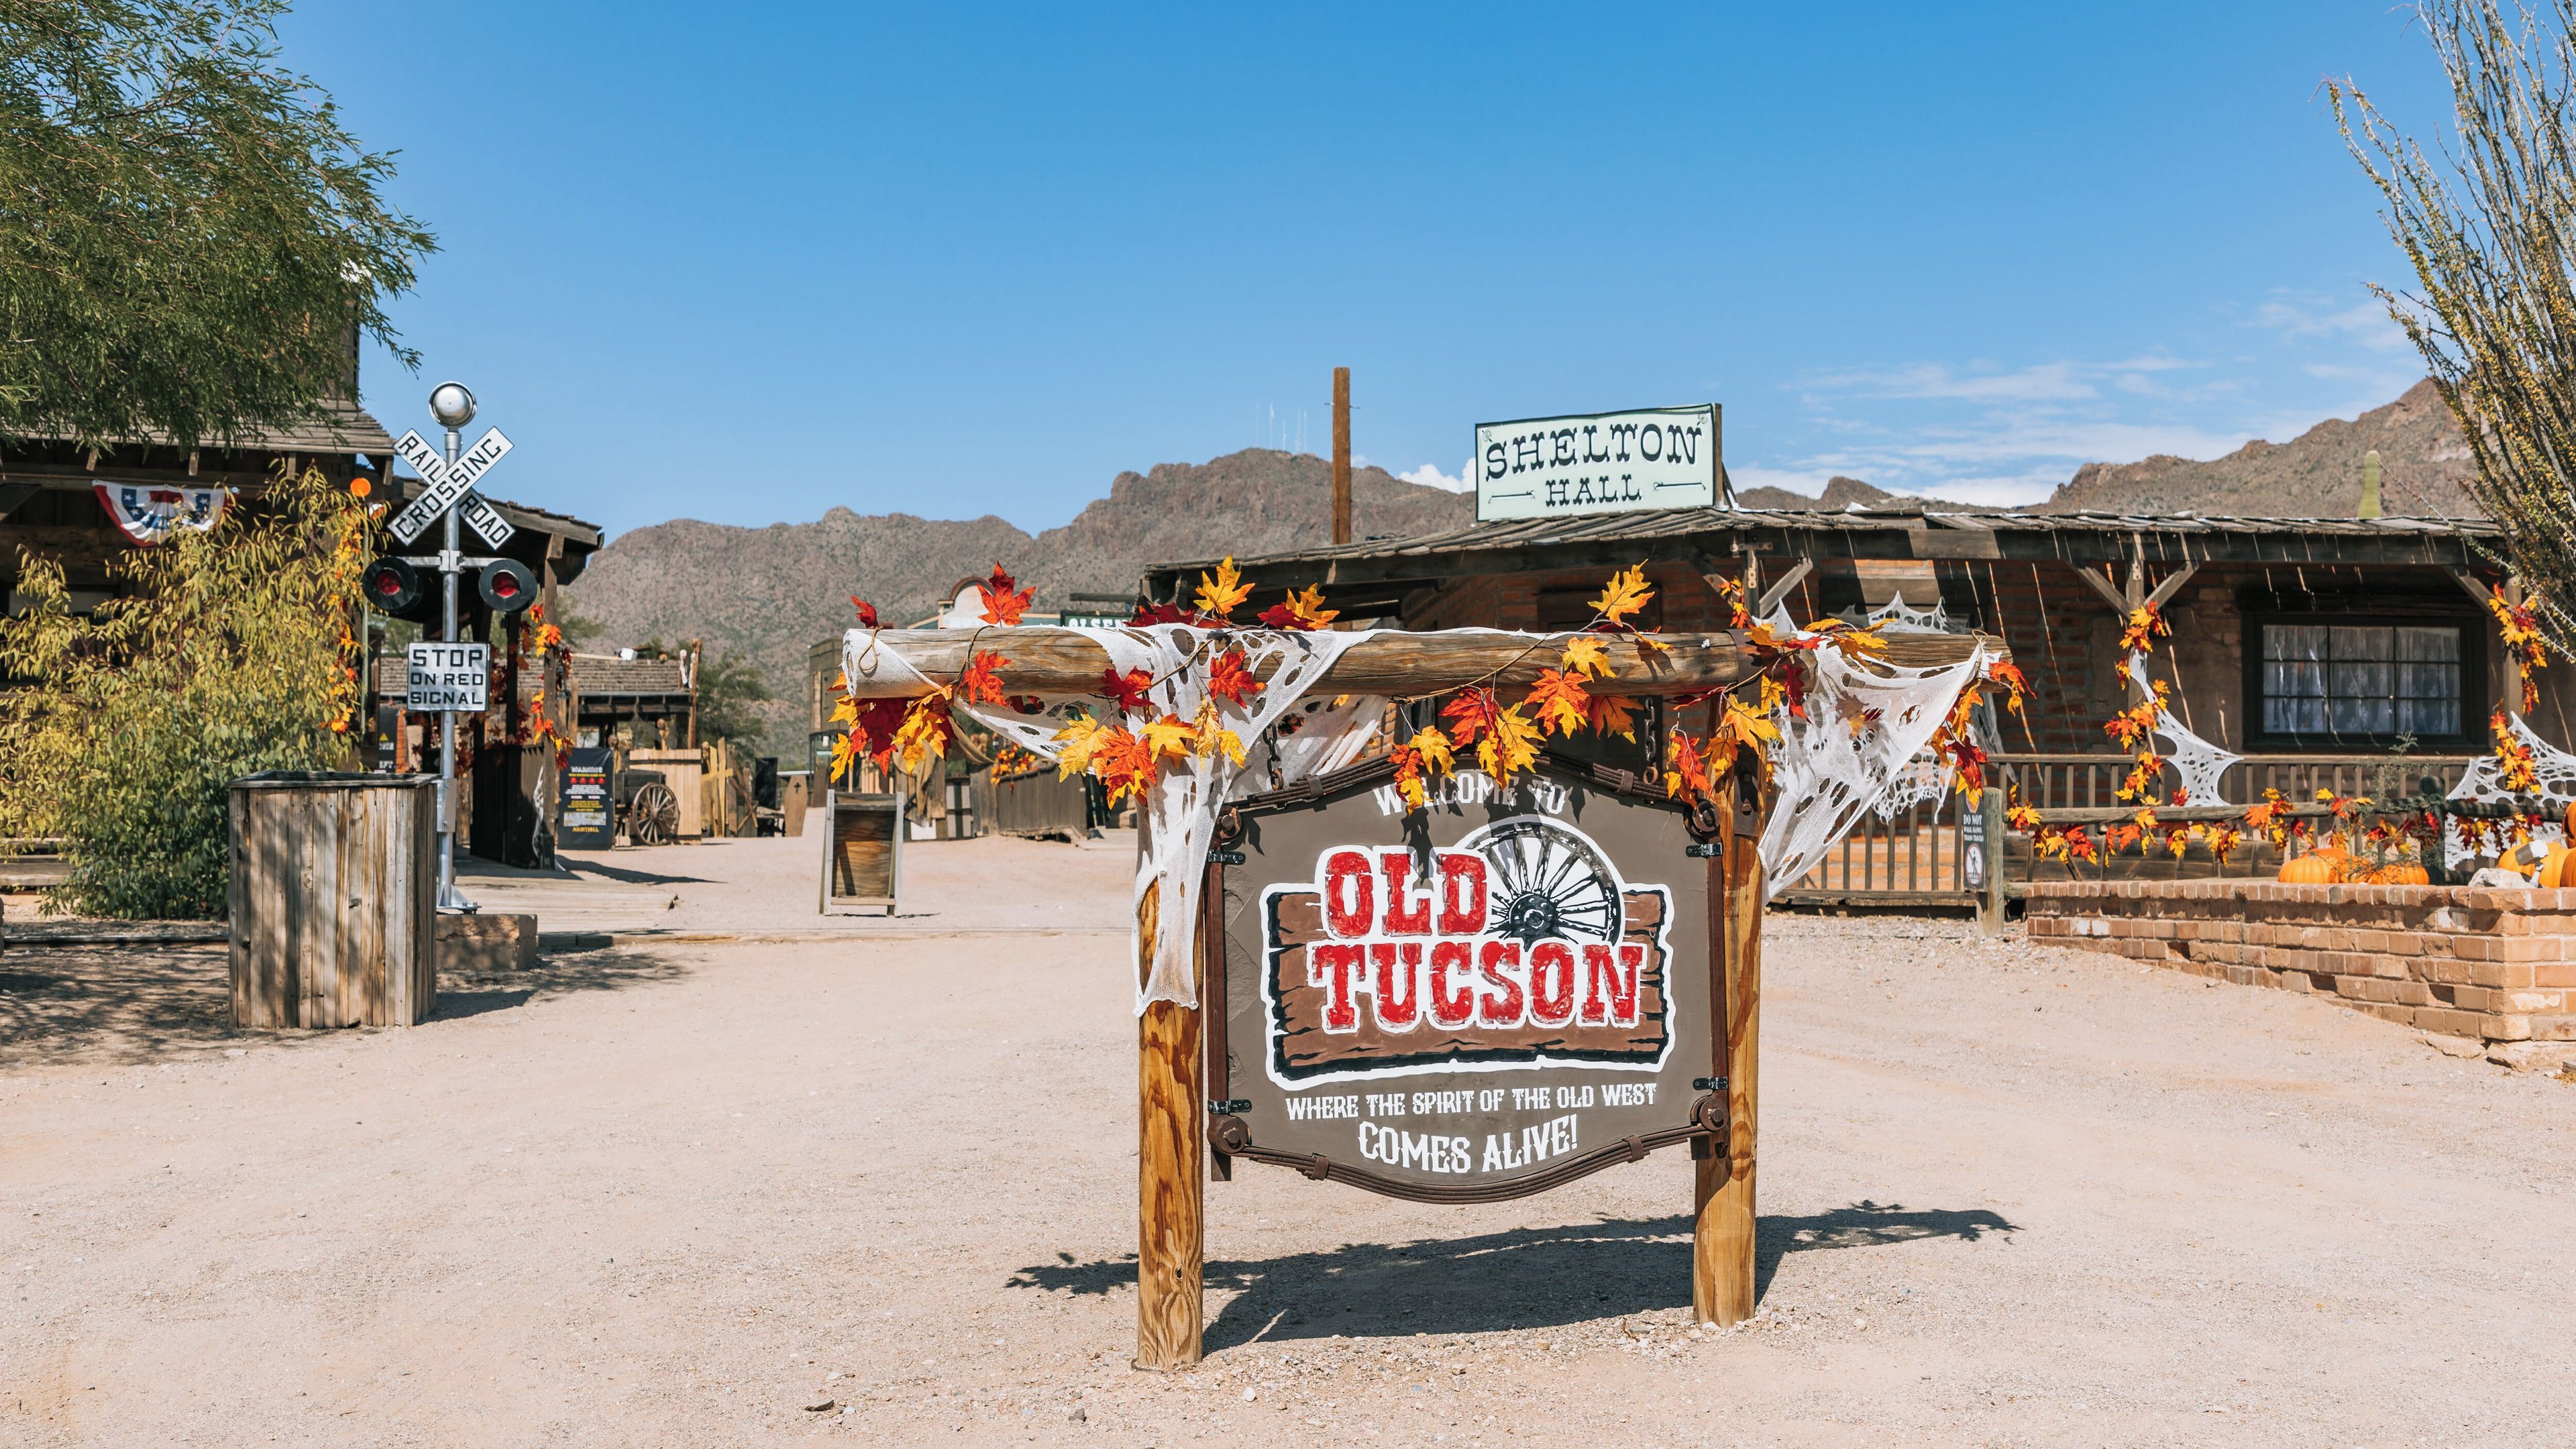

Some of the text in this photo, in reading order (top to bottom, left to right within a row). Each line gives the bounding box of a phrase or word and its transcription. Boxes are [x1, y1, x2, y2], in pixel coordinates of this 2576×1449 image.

[1486, 424, 1703, 482] SHELTON
[395, 438, 502, 538] CROSSING
[398, 435, 510, 543] RAIL ROAD
[1546, 474, 1642, 506] HALL
[413, 649, 483, 667] STOP
[411, 673, 484, 686] ON RED
[411, 692, 483, 704] SIGNAL
[1526, 774, 1566, 815] TO
[1963, 814, 1982, 825] DO NOT
[1325, 851, 1487, 938] OLD
[1312, 941, 1644, 1031] TUCSON
[1285, 1083, 1657, 1120] WHERE THE SPIRIT OF THE OLD WEST
[1358, 1114, 1578, 1173] COMES ALIVE!
